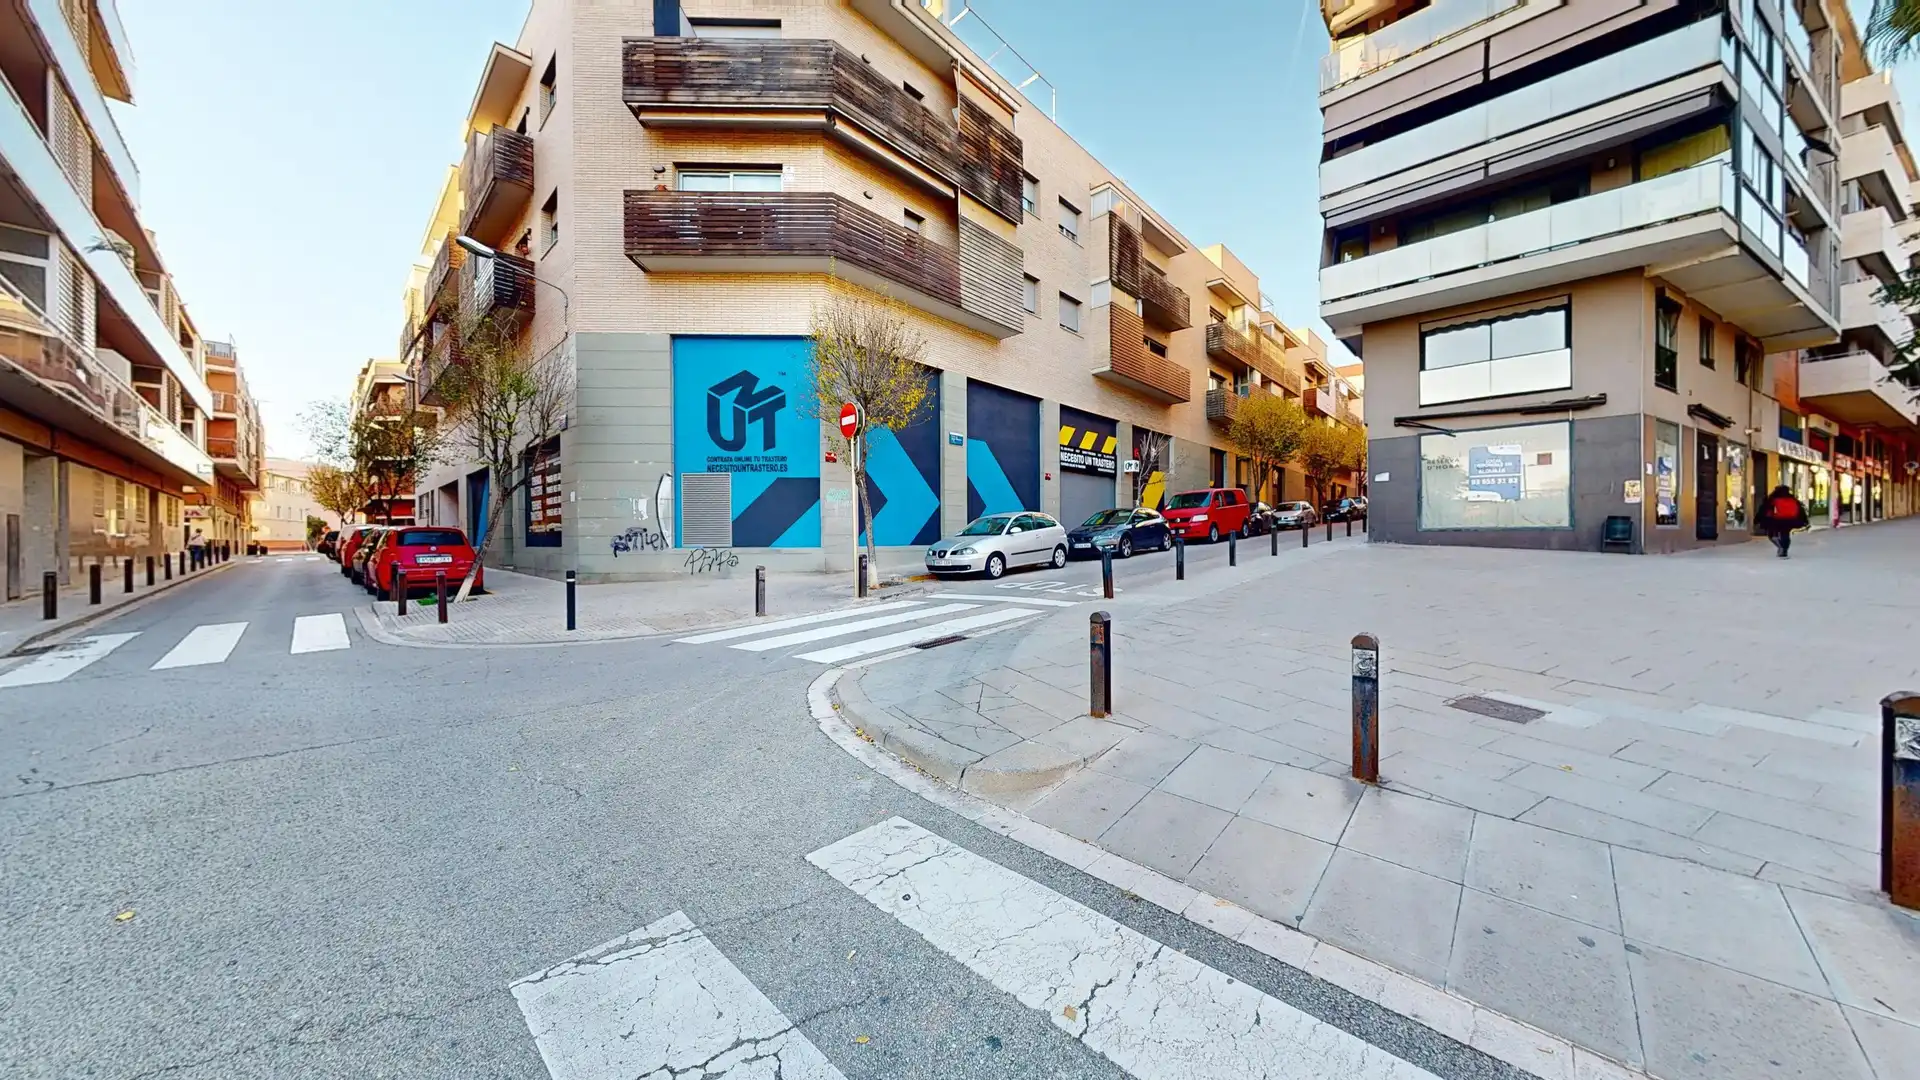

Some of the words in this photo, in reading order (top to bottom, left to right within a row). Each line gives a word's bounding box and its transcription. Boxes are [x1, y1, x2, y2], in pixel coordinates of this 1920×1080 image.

[1060, 451, 1085, 464] NECESITO
[1085, 455, 1093, 466] UN
[1093, 457, 1115, 469] TRASTERO
[706, 464, 788, 472] NECESITOUNTRASTERO.ES
